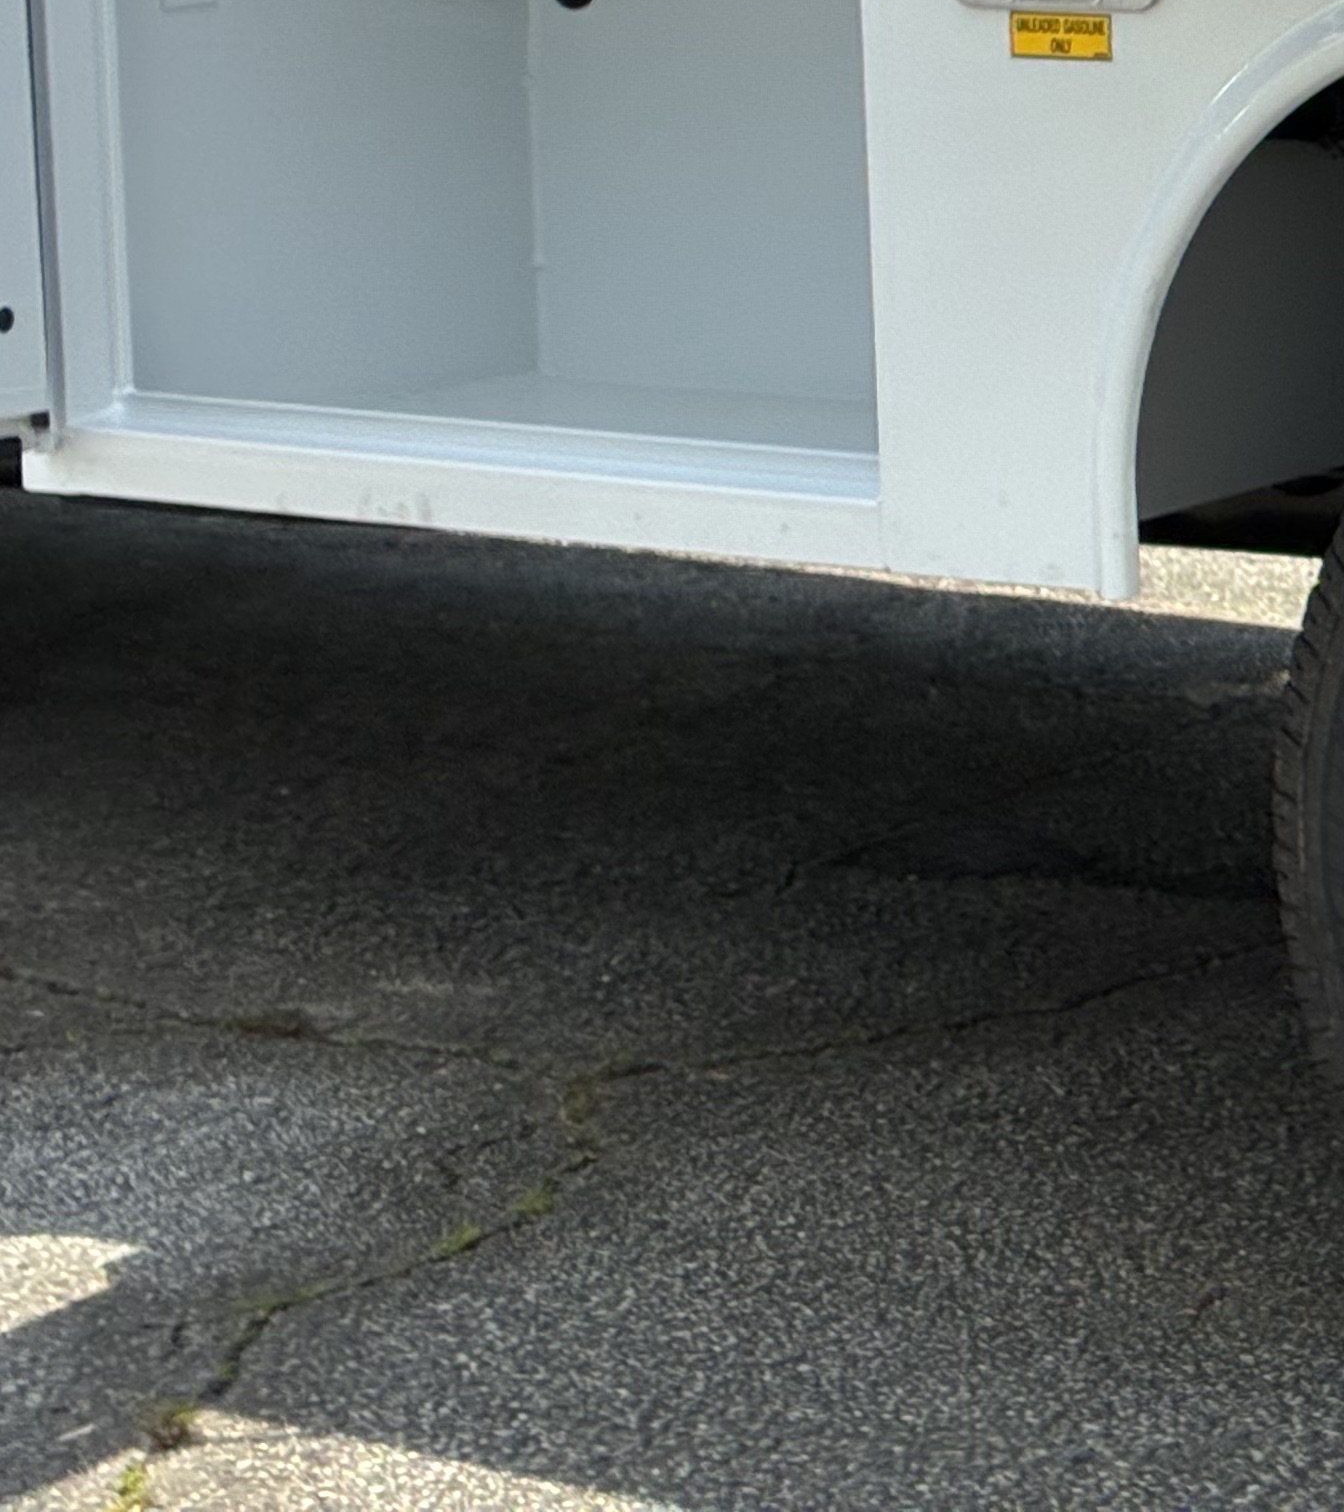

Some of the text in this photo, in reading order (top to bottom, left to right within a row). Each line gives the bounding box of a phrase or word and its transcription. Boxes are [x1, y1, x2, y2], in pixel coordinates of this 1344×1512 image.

[1016, 17, 1106, 36] UNLEADED GASOLINE
[1050, 37, 1073, 54] ONLY
